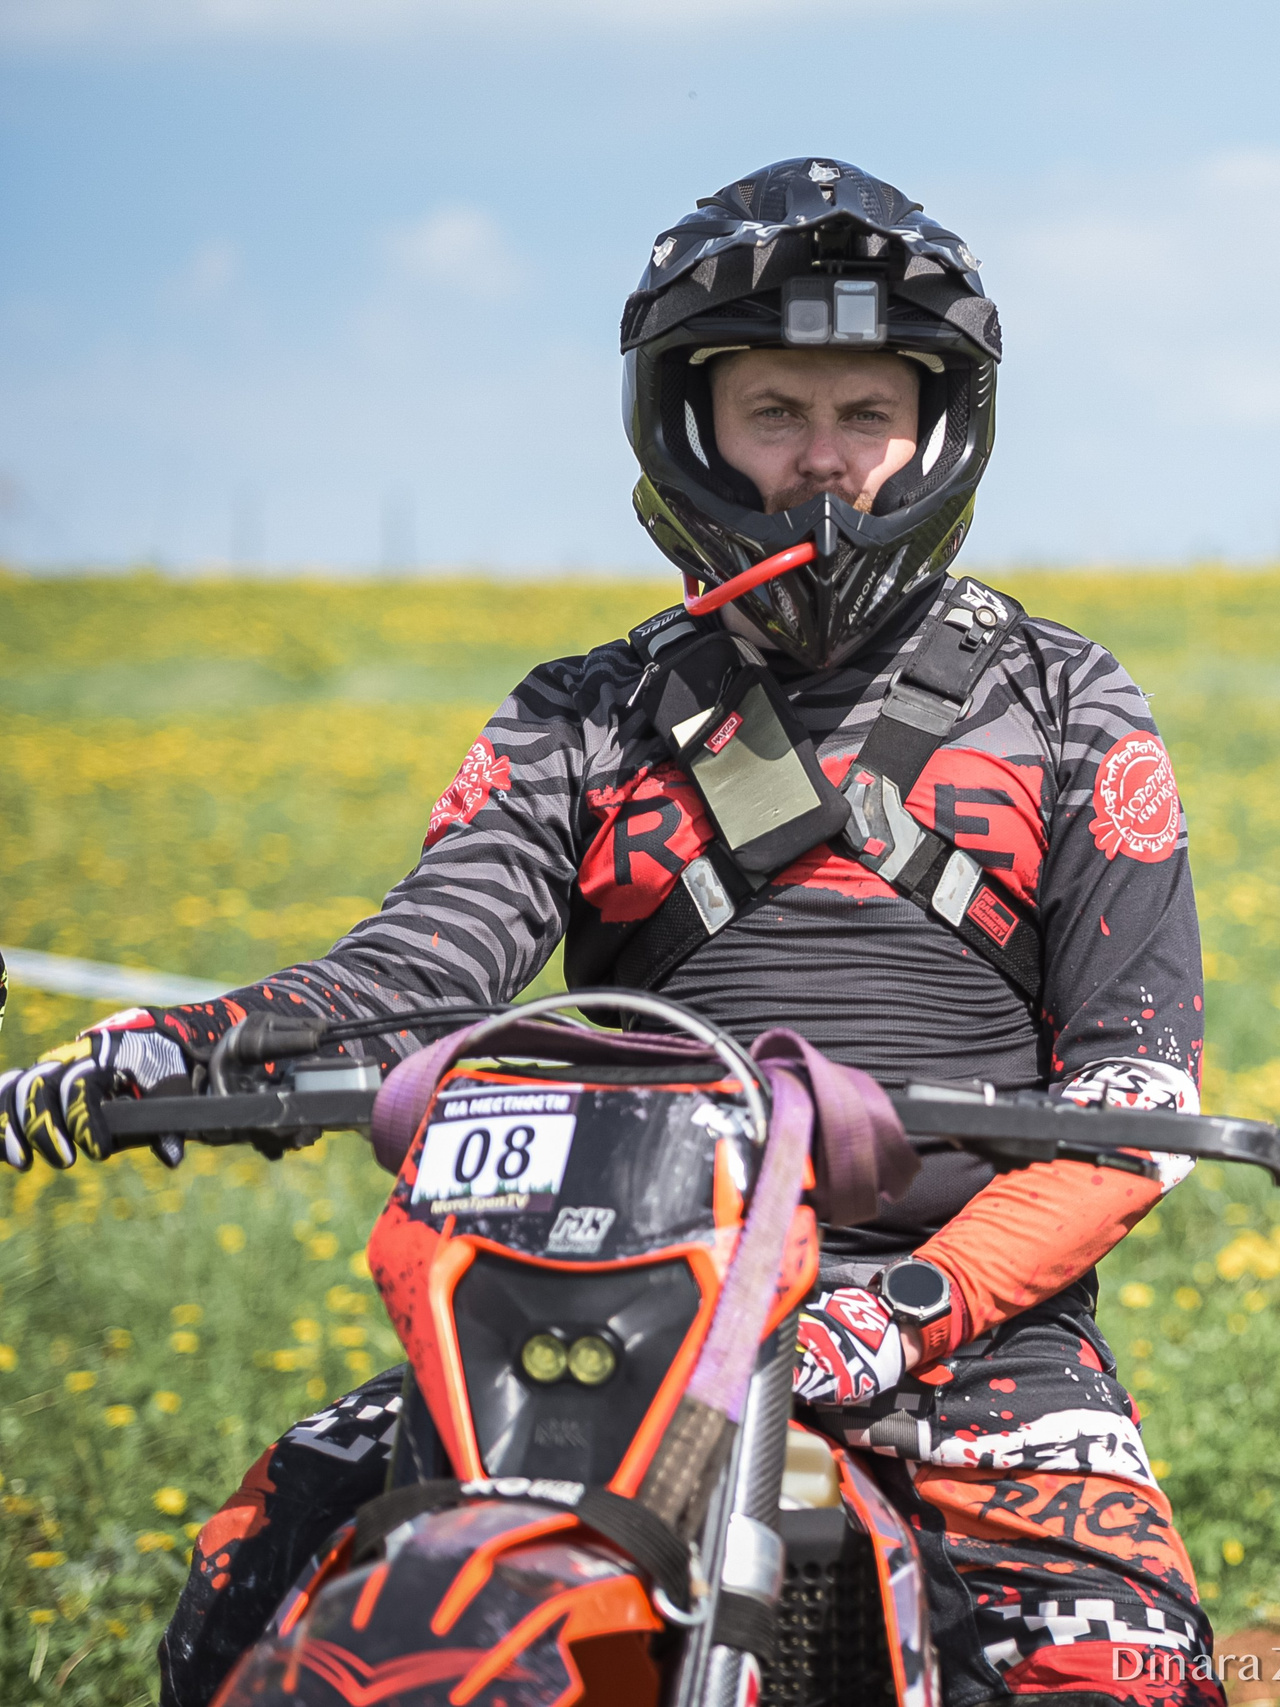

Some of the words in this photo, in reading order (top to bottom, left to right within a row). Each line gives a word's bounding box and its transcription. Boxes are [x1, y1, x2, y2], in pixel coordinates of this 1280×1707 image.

[848, 570, 877, 626] AIROH
[454, 1125, 535, 1184] 08
[967, 1471, 1170, 1545] RACE
